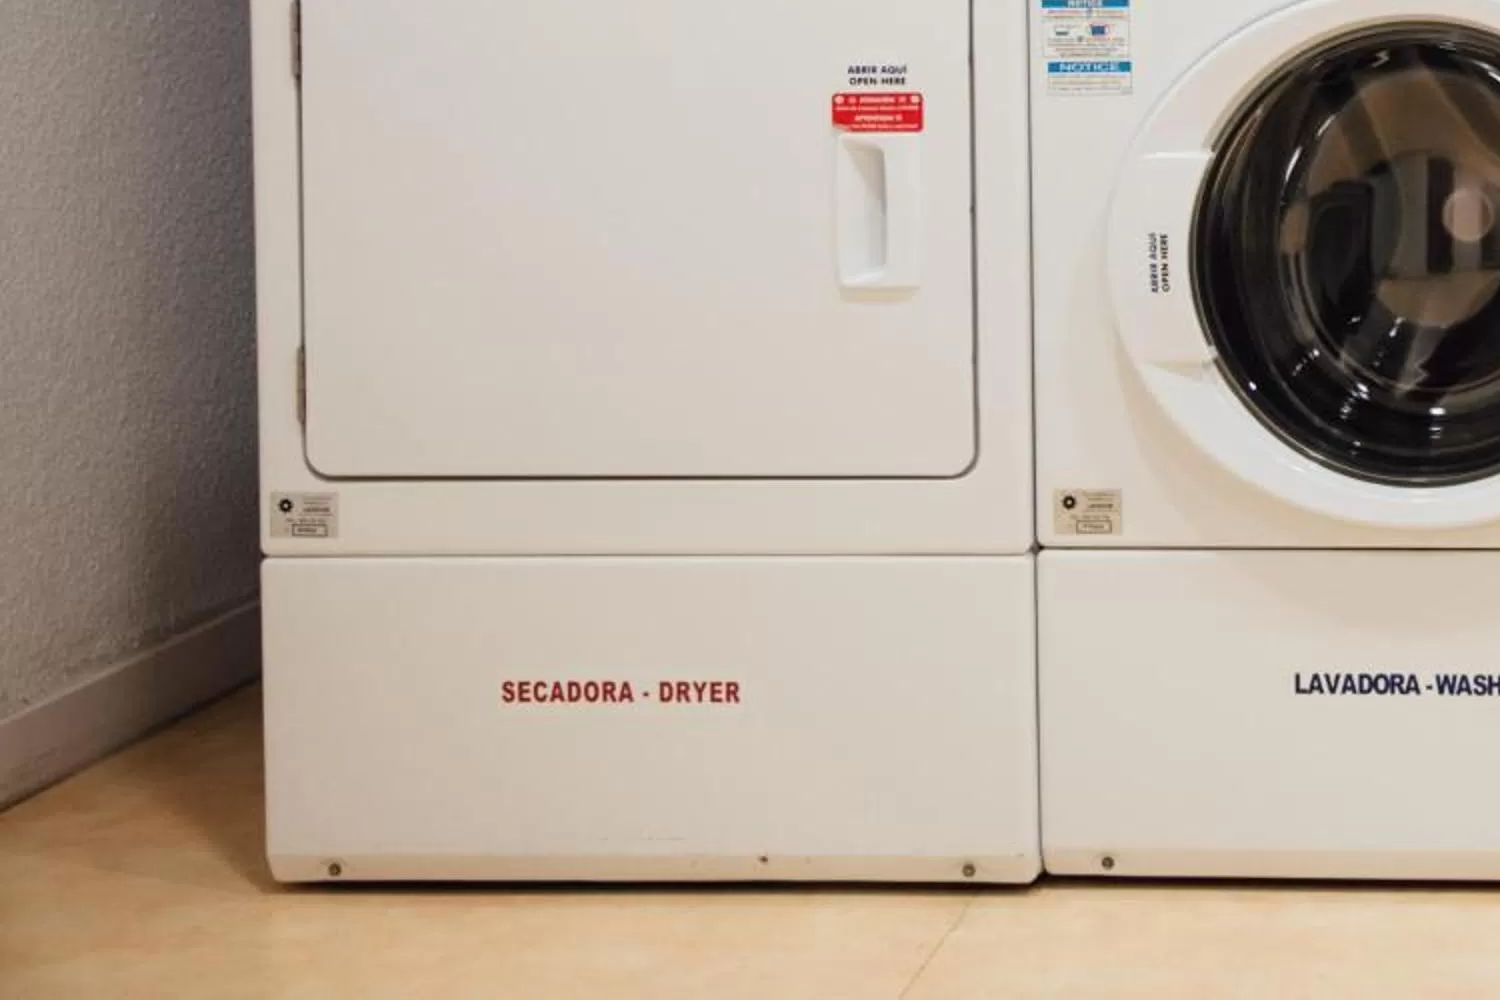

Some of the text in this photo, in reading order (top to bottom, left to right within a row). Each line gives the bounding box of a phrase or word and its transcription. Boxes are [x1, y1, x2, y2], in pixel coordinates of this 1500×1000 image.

[849, 77, 906, 86] OPEN HERE
[501, 680, 635, 704] SECADORA
[658, 681, 741, 704] DRYER
[1294, 673, 1421, 696] LAVADORA
